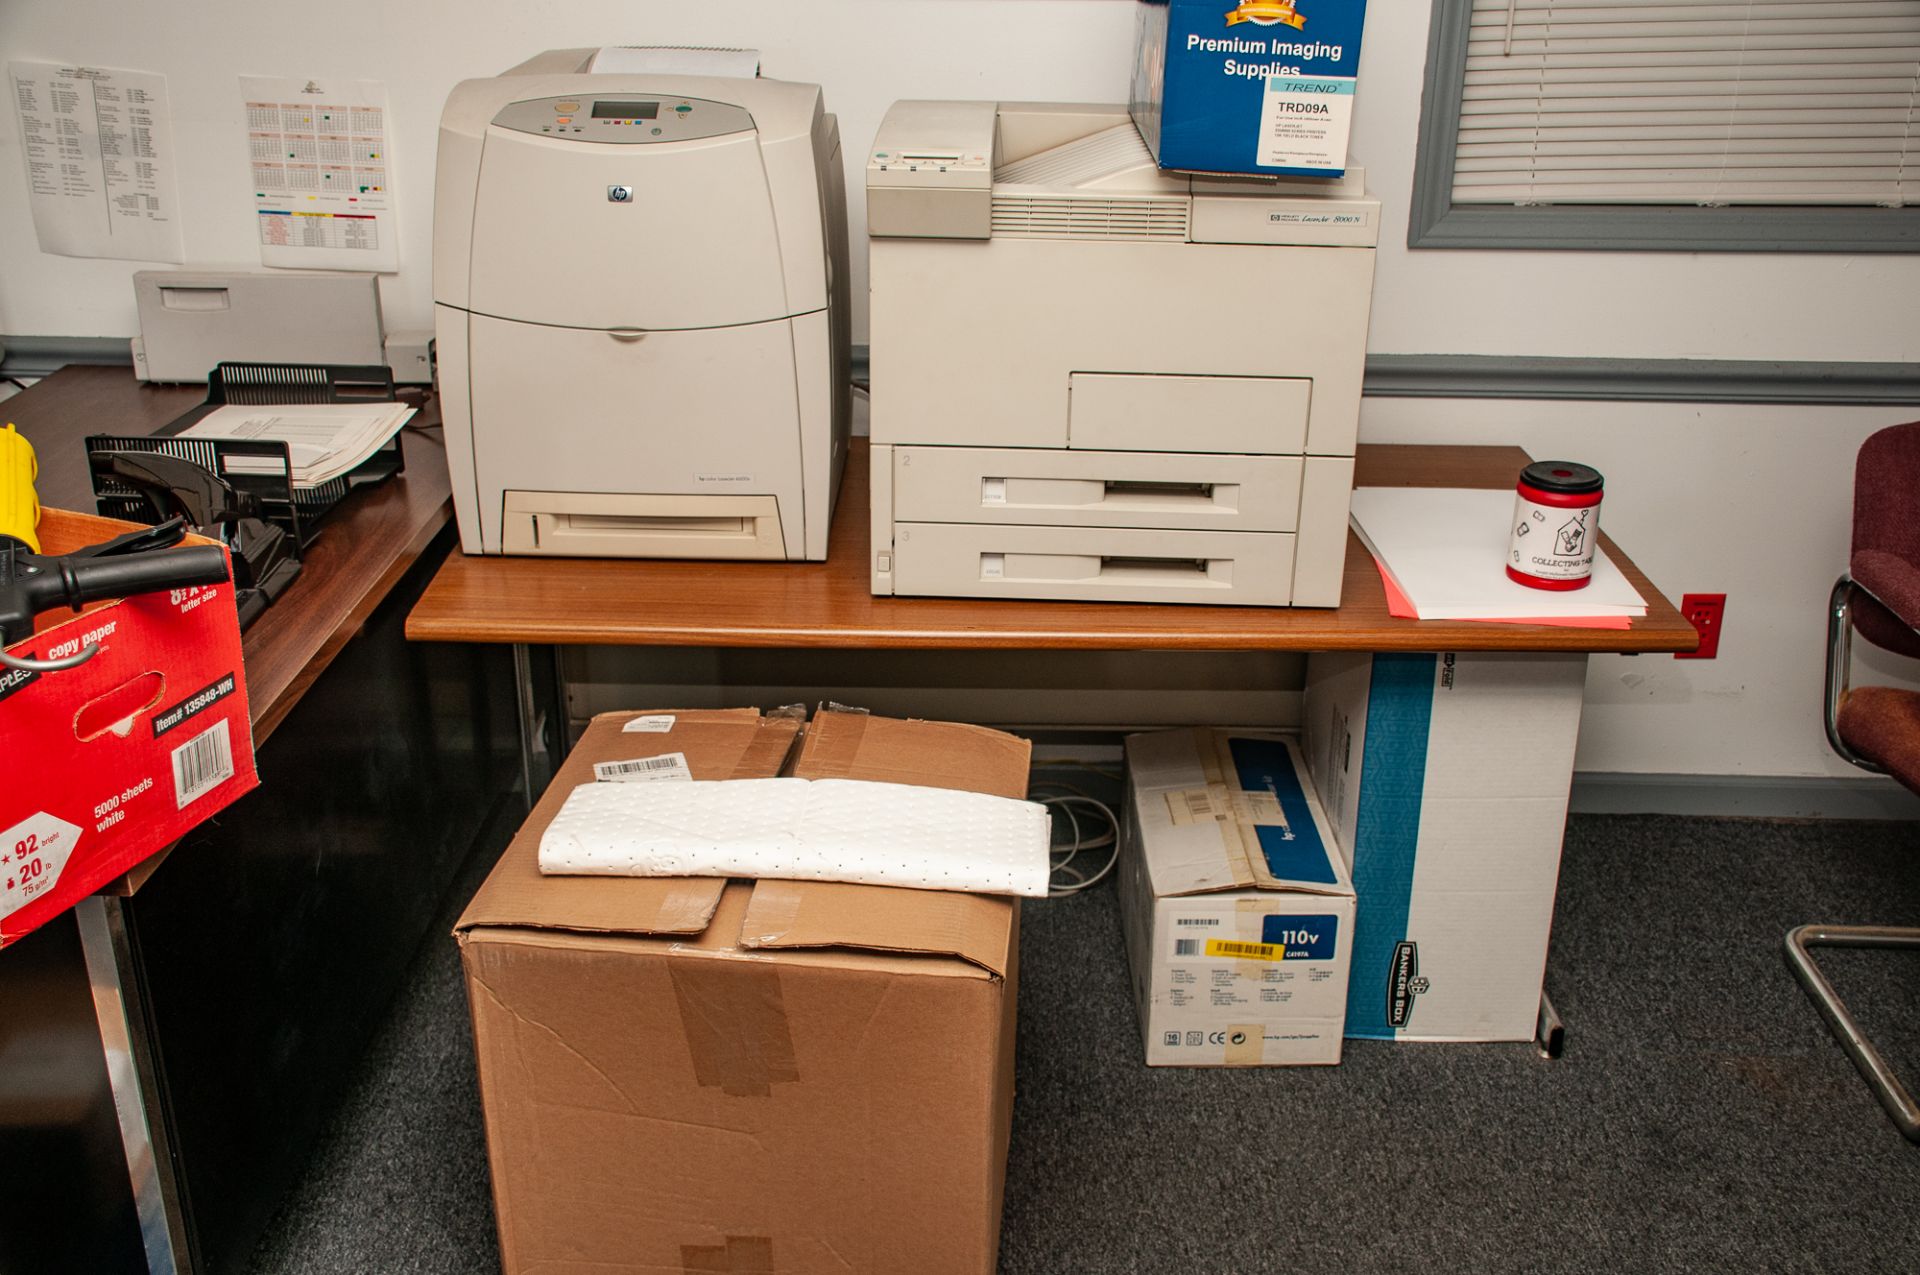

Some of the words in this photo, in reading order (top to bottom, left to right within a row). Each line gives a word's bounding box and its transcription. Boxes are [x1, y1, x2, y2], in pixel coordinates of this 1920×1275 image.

[1187, 34, 1266, 55] Premium
[1271, 38, 1343, 62] Imaging
[1223, 59, 1300, 80] Supplies
[1284, 82, 1338, 93] TREND
[1278, 102, 1329, 114] TRD09A
[1333, 215, 1353, 223] 8000
[902, 455, 911, 466] 2
[902, 531, 910, 541] 3
[1532, 556, 1580, 568] COLLECTING
[181, 599, 201, 614] letter
[202, 589, 217, 602] size
[48, 638, 79, 660] copy
[82, 621, 117, 646] paper
[184, 678, 233, 715] 135848-WH
[94, 795, 119, 819] 5000
[121, 777, 153, 803] sheets
[96, 810, 125, 833] white
[15, 833, 39, 860] 92
[41, 832, 60, 847] bright
[19, 858, 42, 885] 20
[22, 883, 35, 897] 75
[1281, 930, 1320, 945] 110v
[1396, 946, 1411, 998] BANKERS
[1393, 999, 1405, 1022] BOX
